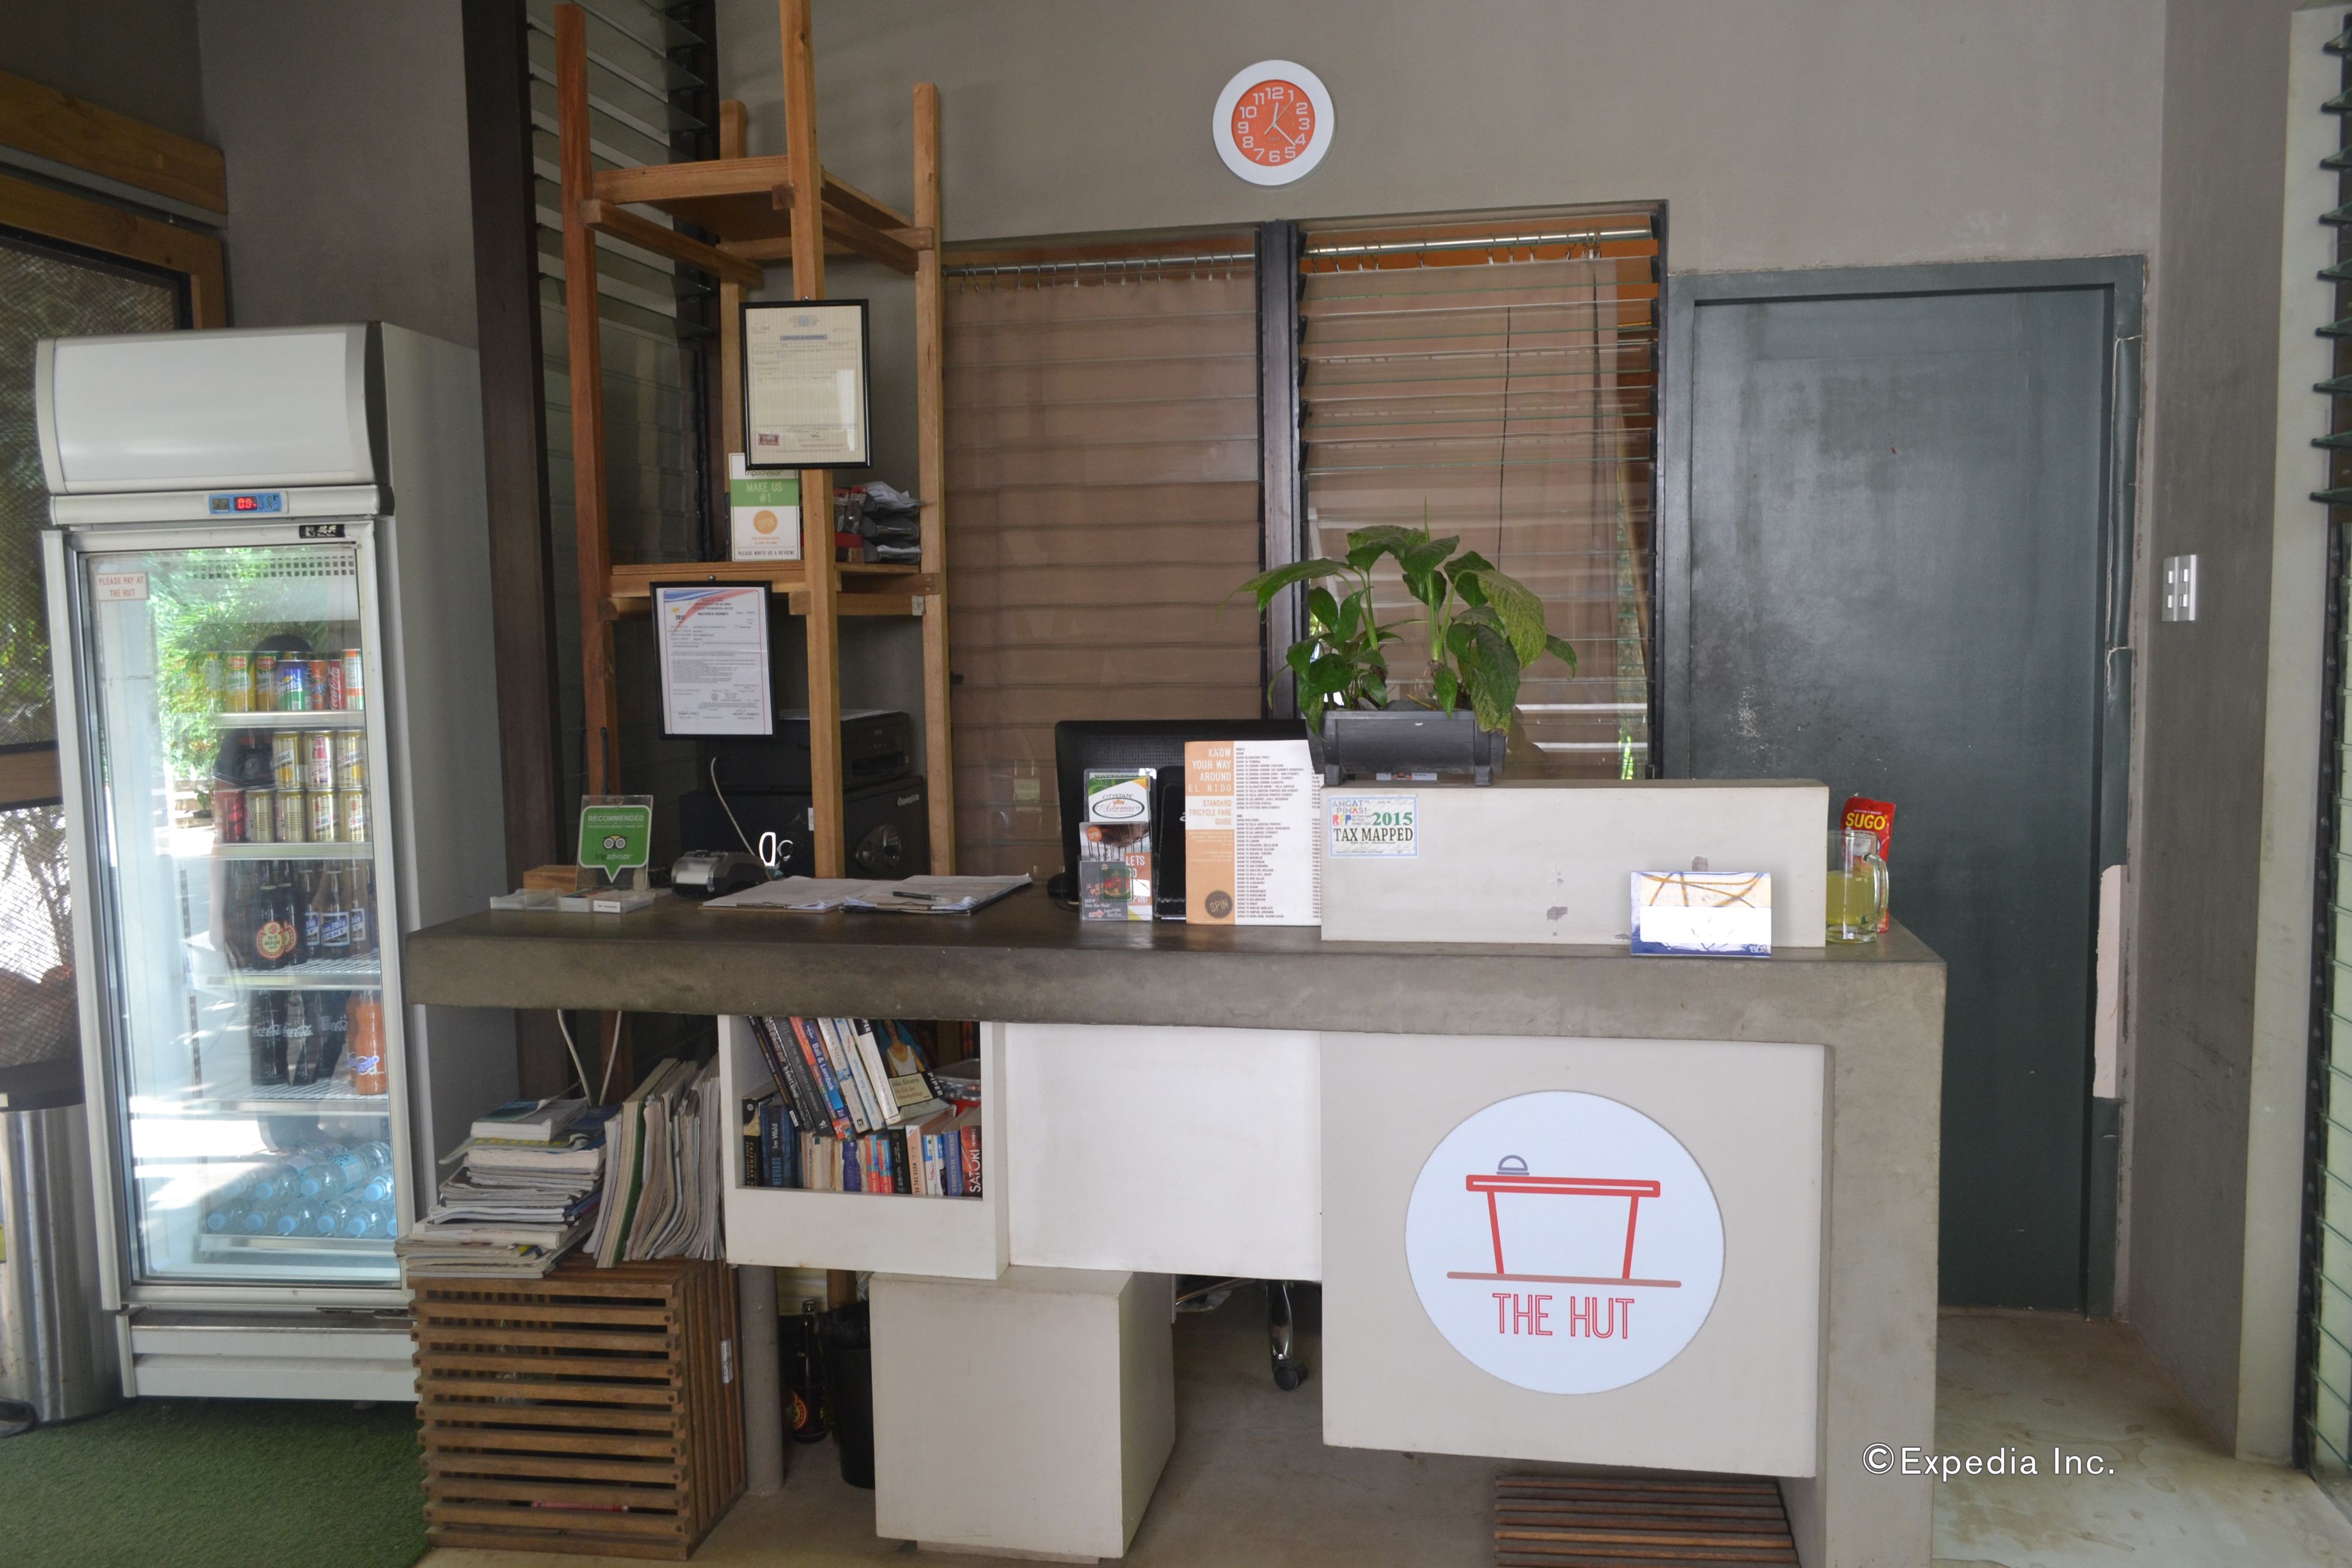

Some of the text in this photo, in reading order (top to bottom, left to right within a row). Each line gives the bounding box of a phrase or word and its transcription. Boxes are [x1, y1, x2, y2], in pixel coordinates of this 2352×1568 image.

[1253, 92, 1264, 105] 11
[1265, 87, 1283, 99] 12
[1289, 90, 1294, 100] 1
[1240, 107, 1256, 118] 10
[1296, 103, 1308, 115] 2
[1237, 121, 1249, 134] 9
[1298, 118, 1310, 130] 3
[1243, 136, 1254, 148] 8
[1295, 134, 1306, 145] 4
[1254, 148, 1264, 160] 7
[1269, 151, 1280, 162] 6
[1285, 147, 1295, 159] 5
[747, 483, 783, 492] MAKE US
[760, 494, 771, 503] #1
[757, 517, 774, 529] SPIN
[1208, 748, 1231, 757] KNOW
[1193, 761, 1231, 769] YOUR WAY
[1200, 772, 1231, 782] AROUND
[1333, 815, 1352, 826] RFP
[1372, 812, 1412, 826] 2015
[1845, 812, 1886, 830] SUGO
[1333, 828, 1413, 842] TAX MAPPED
[1126, 856, 1145, 866] LETS
[1209, 898, 1229, 913] SPIN
[323, 929, 344, 940] LIGHT
[812, 1042, 821, 1056] Bali
[820, 1064, 834, 1091] Lombok
[928, 1072, 943, 1096] PIPER
[969, 1149, 981, 1193] SATORI
[1492, 1292, 1635, 1340] THE HUT
